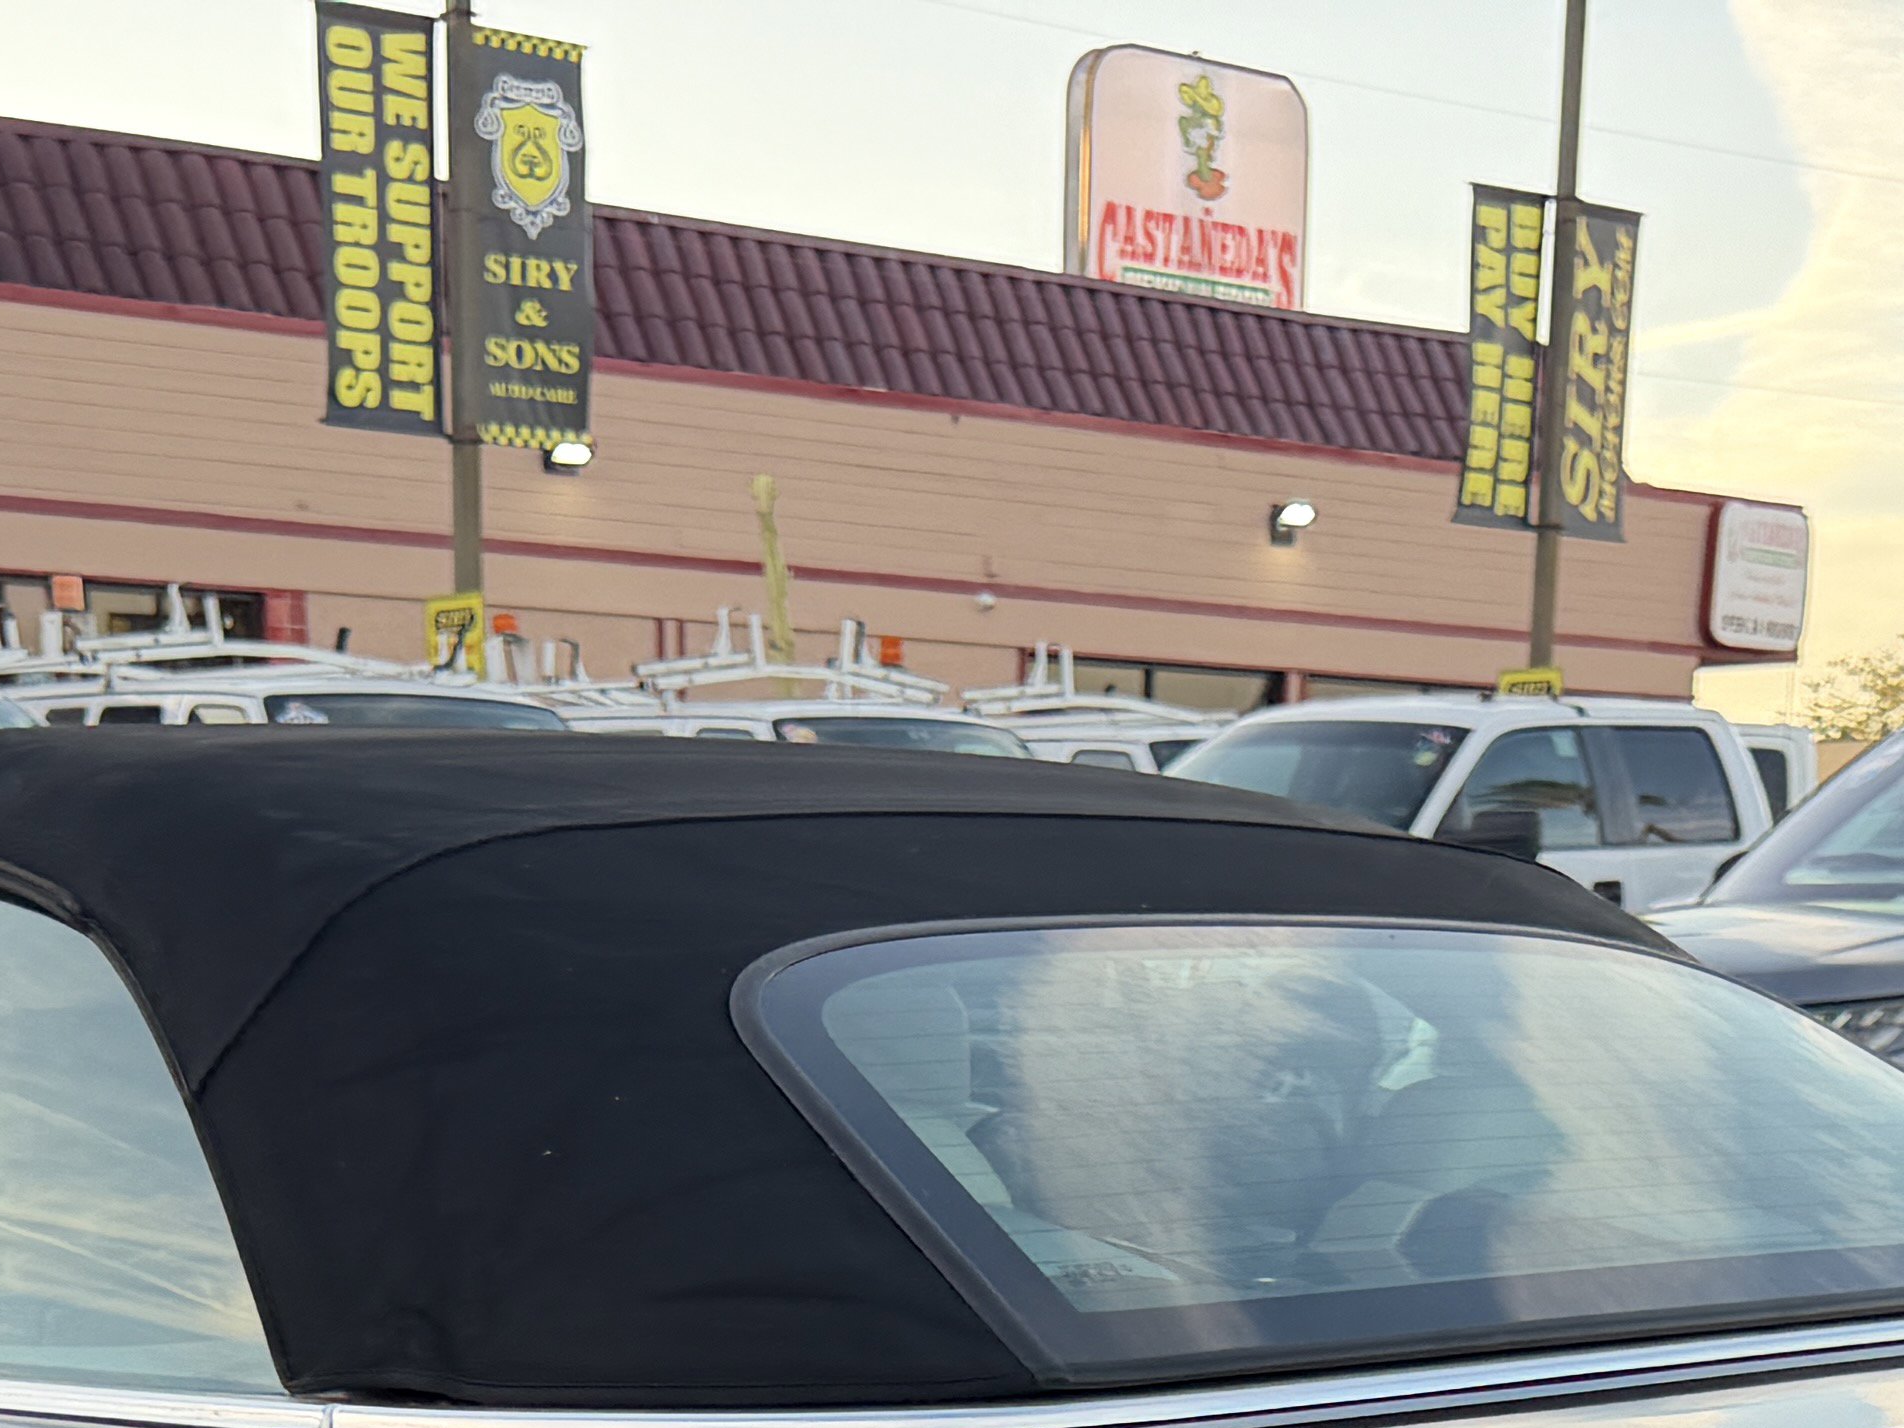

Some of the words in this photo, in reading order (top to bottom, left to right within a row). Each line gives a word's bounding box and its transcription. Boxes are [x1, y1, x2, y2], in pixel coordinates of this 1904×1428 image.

[325, 25, 376, 155] OUR
[380, 33, 429, 131] WE
[330, 168, 382, 409] TROOPS
[383, 139, 434, 421] SUPPORT
[483, 253, 579, 292] SIRY
[515, 298, 549, 328] &
[1473, 205, 1512, 330] PAY
[1508, 203, 1542, 343] BUY
[484, 336, 581, 375] SONS
[1560, 215, 1613, 523] SIRY
[1462, 342, 1503, 508] HERE
[1495, 355, 1533, 518] HERE
